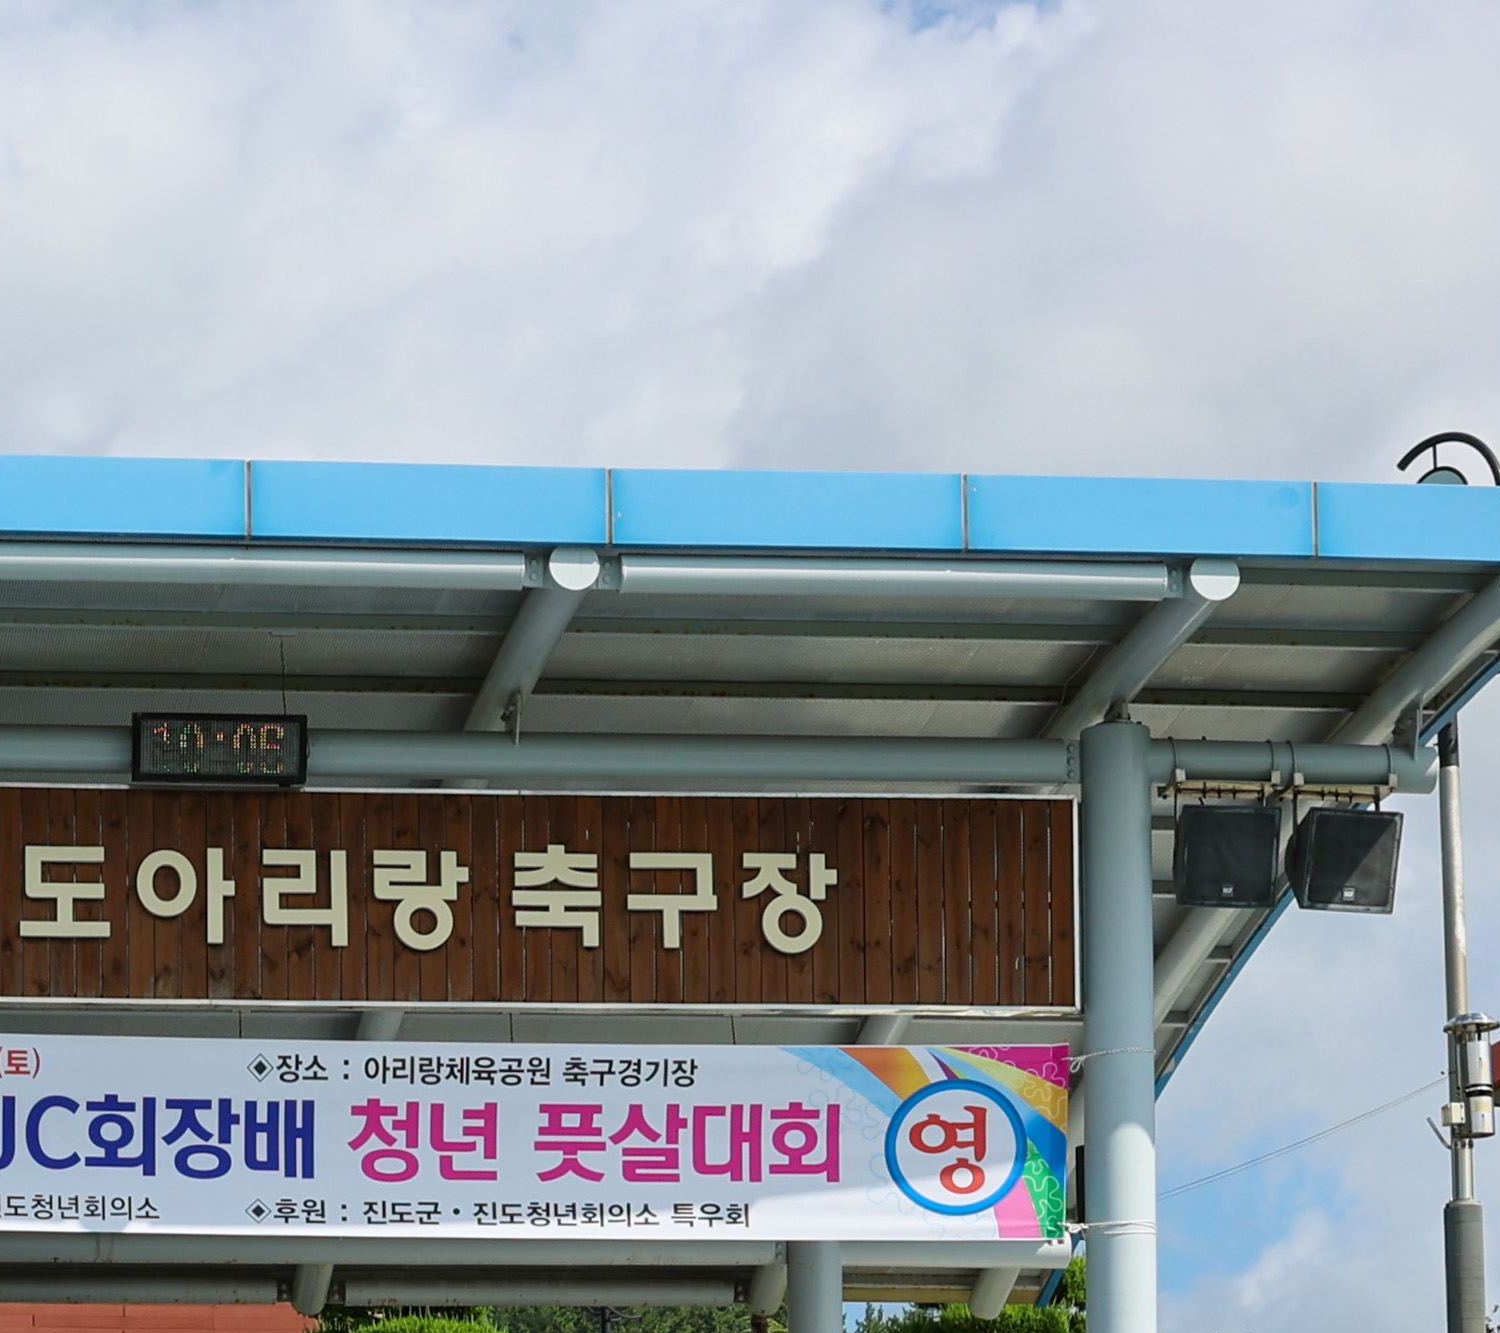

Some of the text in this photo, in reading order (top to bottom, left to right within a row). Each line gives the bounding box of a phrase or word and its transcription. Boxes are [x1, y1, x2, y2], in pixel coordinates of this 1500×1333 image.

[511, 844, 838, 954] 축구장
[275, 1054, 330, 1083] 장소
[363, 1056, 552, 1086] 아리랑체육공원
[562, 1058, 698, 1088] 축구경기장
[347, 1097, 499, 1183] 청년
[533, 1101, 841, 1184] 풋살대회
[908, 1105, 989, 1194] 영
[272, 1198, 328, 1226] 후원
[362, 1200, 442, 1226] 진도군
[472, 1201, 661, 1229] 진도청년회의소
[670, 1202, 751, 1229] 특우회
